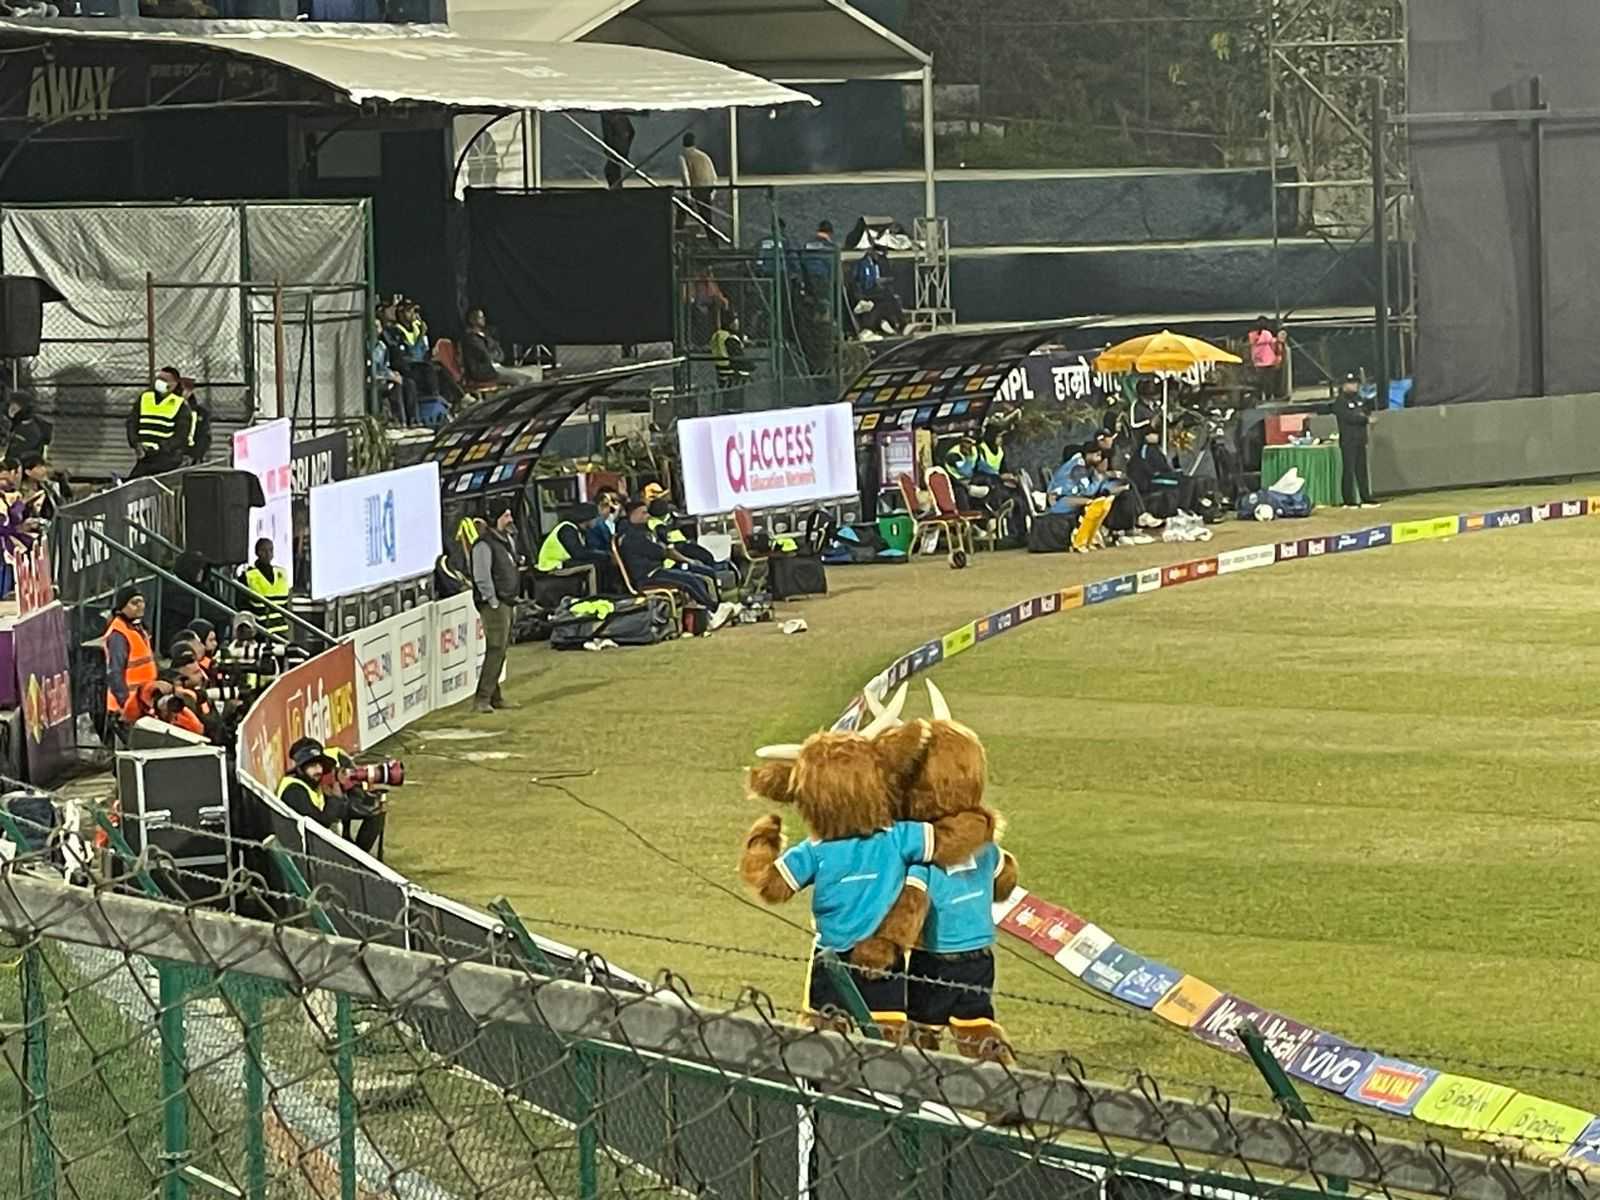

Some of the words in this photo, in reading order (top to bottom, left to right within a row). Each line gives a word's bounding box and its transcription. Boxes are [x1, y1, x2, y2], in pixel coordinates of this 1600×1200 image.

[28, 66, 115, 121] AWAY
[750, 424, 815, 471] ACCESS
[1300, 1046, 1362, 1085] vivo
